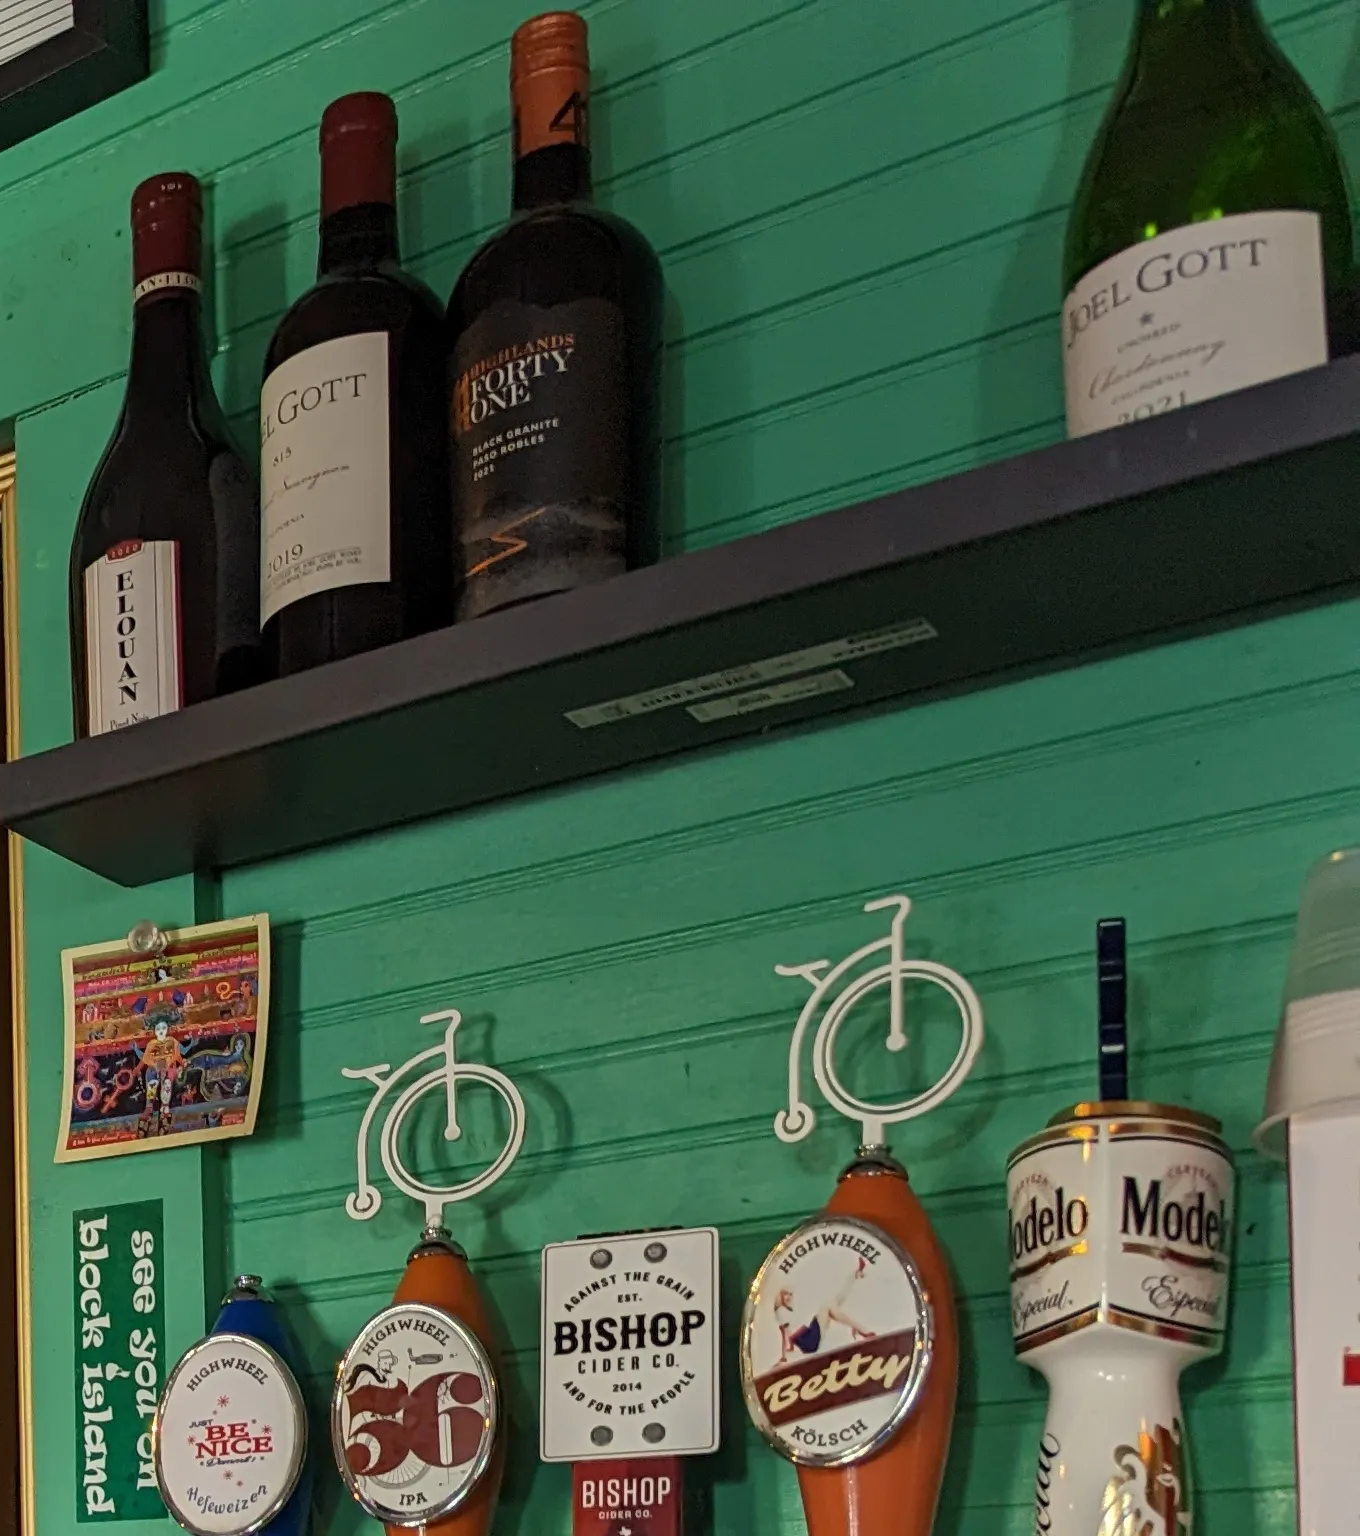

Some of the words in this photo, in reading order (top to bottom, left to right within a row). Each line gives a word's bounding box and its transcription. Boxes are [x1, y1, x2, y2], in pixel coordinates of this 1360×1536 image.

[1066, 281, 1130, 349] JOEL
[1136, 238, 1269, 293] GOTT
[471, 348, 574, 402] FORTY
[277, 373, 367, 425] GOTT
[470, 380, 530, 424] ONE
[472, 433, 503, 457] BLACK
[506, 417, 560, 440] GRANITE
[473, 450, 497, 469] PASO
[500, 434, 545, 455] ROBLES
[116, 569, 139, 705] ELOUAN
[1009, 1186, 1089, 1262] odelo
[1121, 1175, 1228, 1250] Model
[131, 1230, 156, 1314] see
[779, 1230, 882, 1275] HIGHWHEEL
[78, 1214, 111, 1349] block
[564, 1273, 618, 1313] AGAINST
[624, 1271, 651, 1283] THE
[656, 1273, 696, 1301] GRAIN
[617, 1293, 643, 1303] EST.
[360, 1317, 453, 1358] HIGHWHEEL
[553, 1309, 706, 1356] BISHOP
[129, 1327, 158, 1418] you
[186, 1357, 269, 1392] HIGHWHEEL
[578, 1356, 640, 1375] CIDER
[652, 1353, 679, 1369] CO.
[764, 1351, 910, 1414] Betty
[562, 1380, 586, 1404] AND
[588, 1399, 613, 1416] FOR
[619, 1402, 646, 1416] THE
[651, 1370, 696, 1410] PEOPLE
[612, 1381, 642, 1392] 2014
[81, 1362, 117, 1516] island
[189, 1418, 213, 1429] JUST
[205, 1422, 249, 1441] BE
[344, 1371, 486, 1477] 56
[790, 1418, 868, 1448] KÖLSCH
[195, 1436, 273, 1459] NICE
[187, 1484, 267, 1515] Hefeweizen
[399, 1490, 428, 1507] IPA
[582, 1476, 671, 1508] BISHOP
[598, 1510, 632, 1520] CIDER
